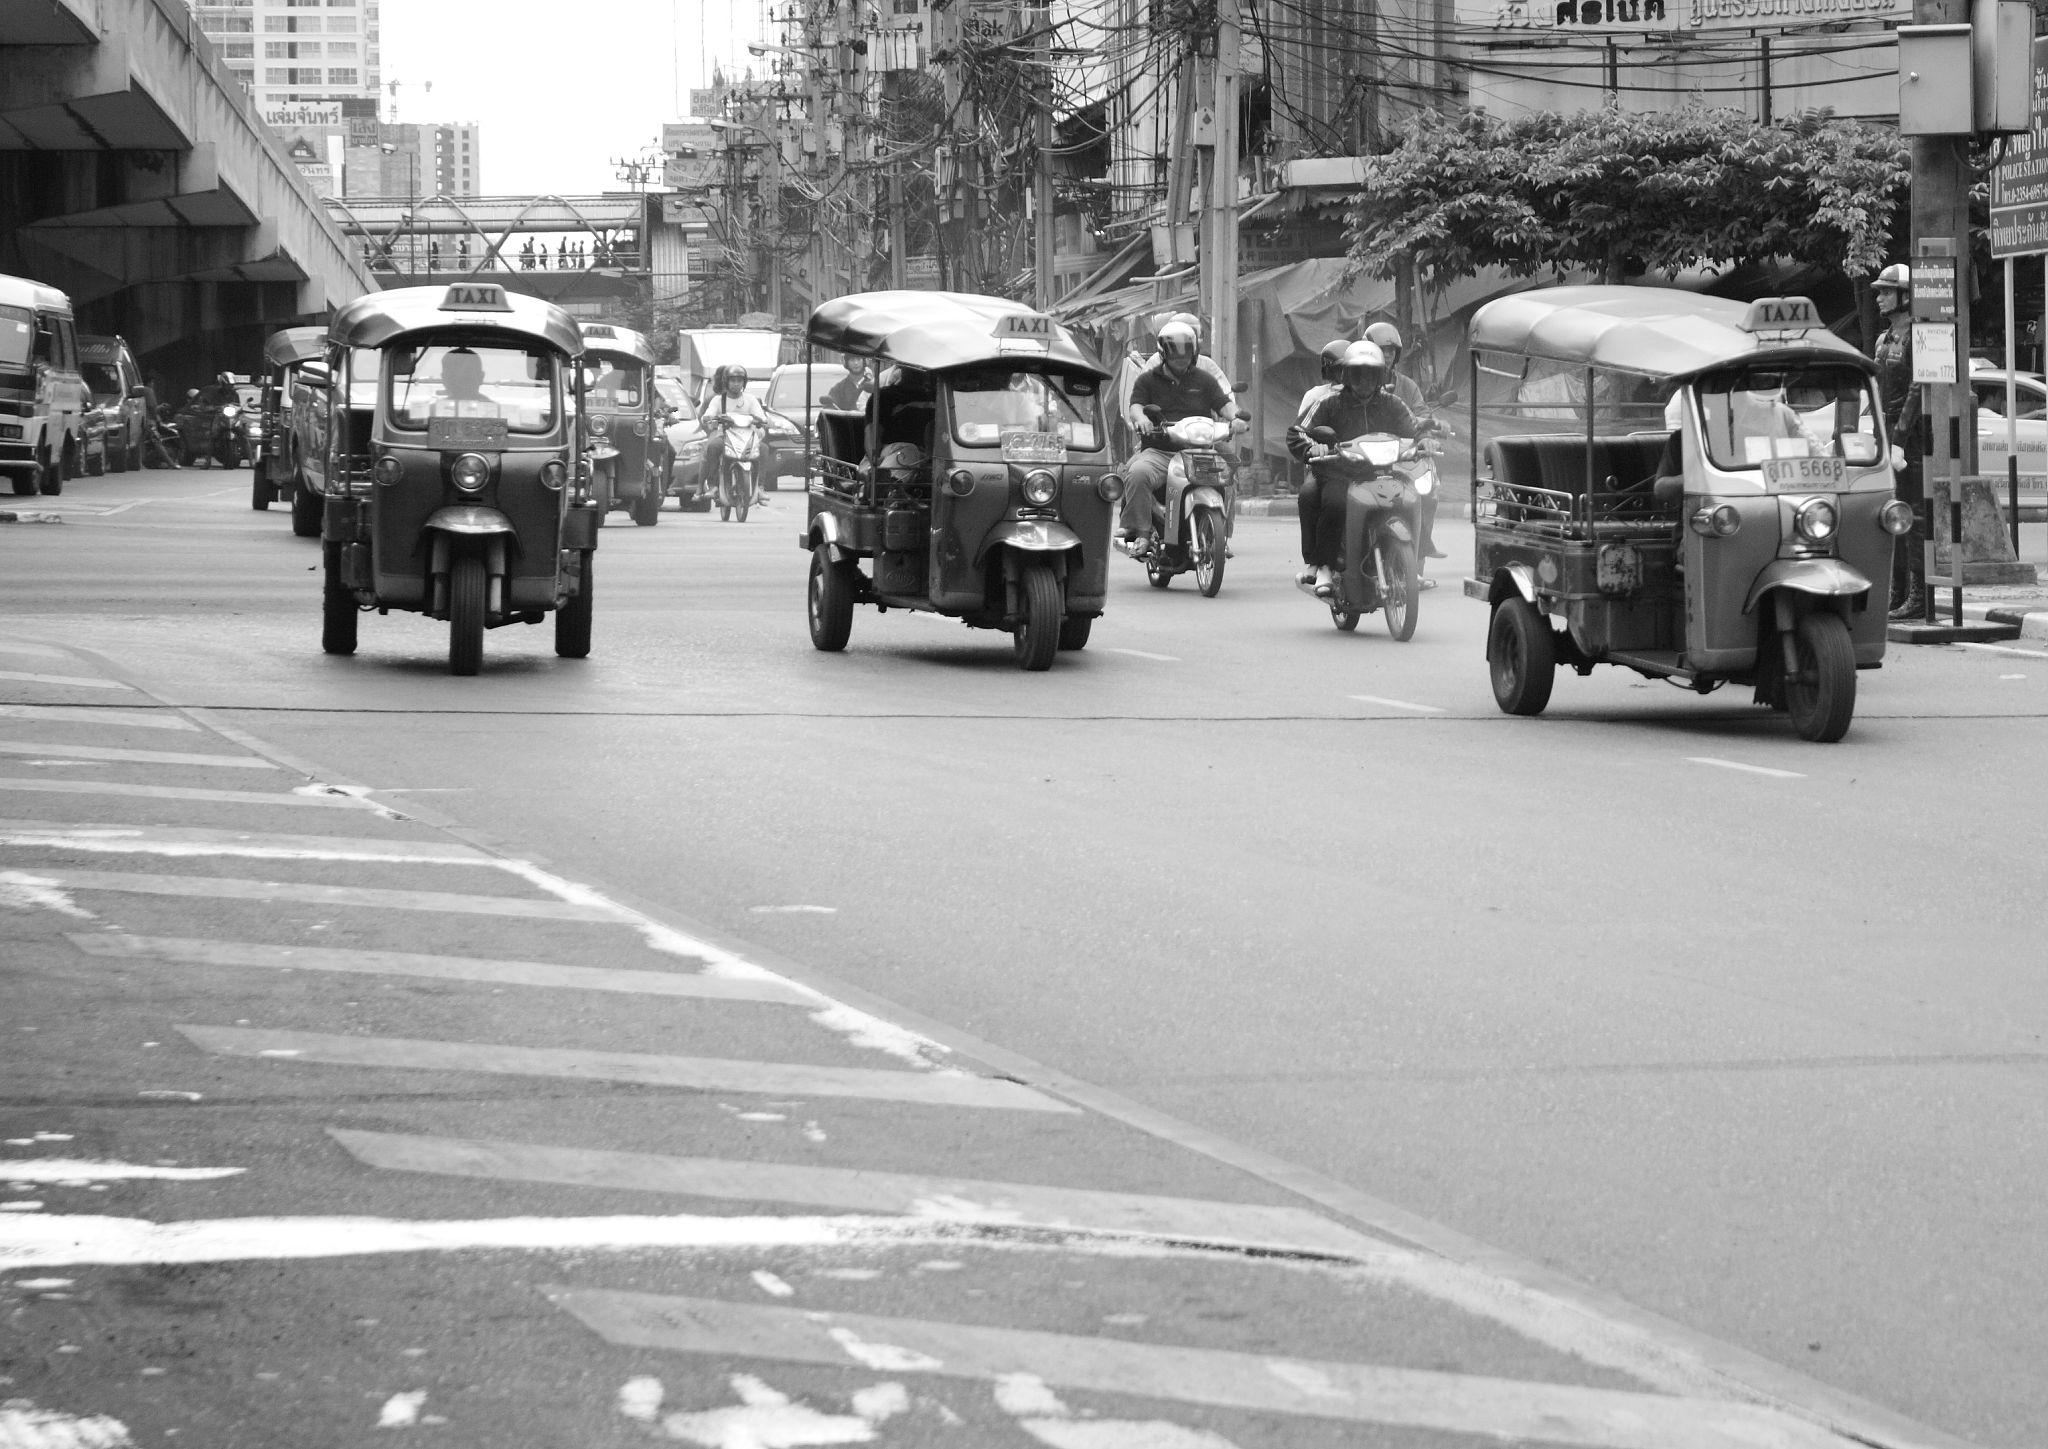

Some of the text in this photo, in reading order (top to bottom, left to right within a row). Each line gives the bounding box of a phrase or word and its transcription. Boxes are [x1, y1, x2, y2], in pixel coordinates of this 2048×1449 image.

[266, 105, 338, 125] แจ่มจันทร์
[2002, 162, 2022, 181] POLICE
[452, 288, 497, 305] TAXI
[1760, 303, 1810, 322] TAXI
[589, 326, 612, 335] TAXI
[1008, 317, 1050, 333] TAXI
[1940, 364, 1955, 378] 1772
